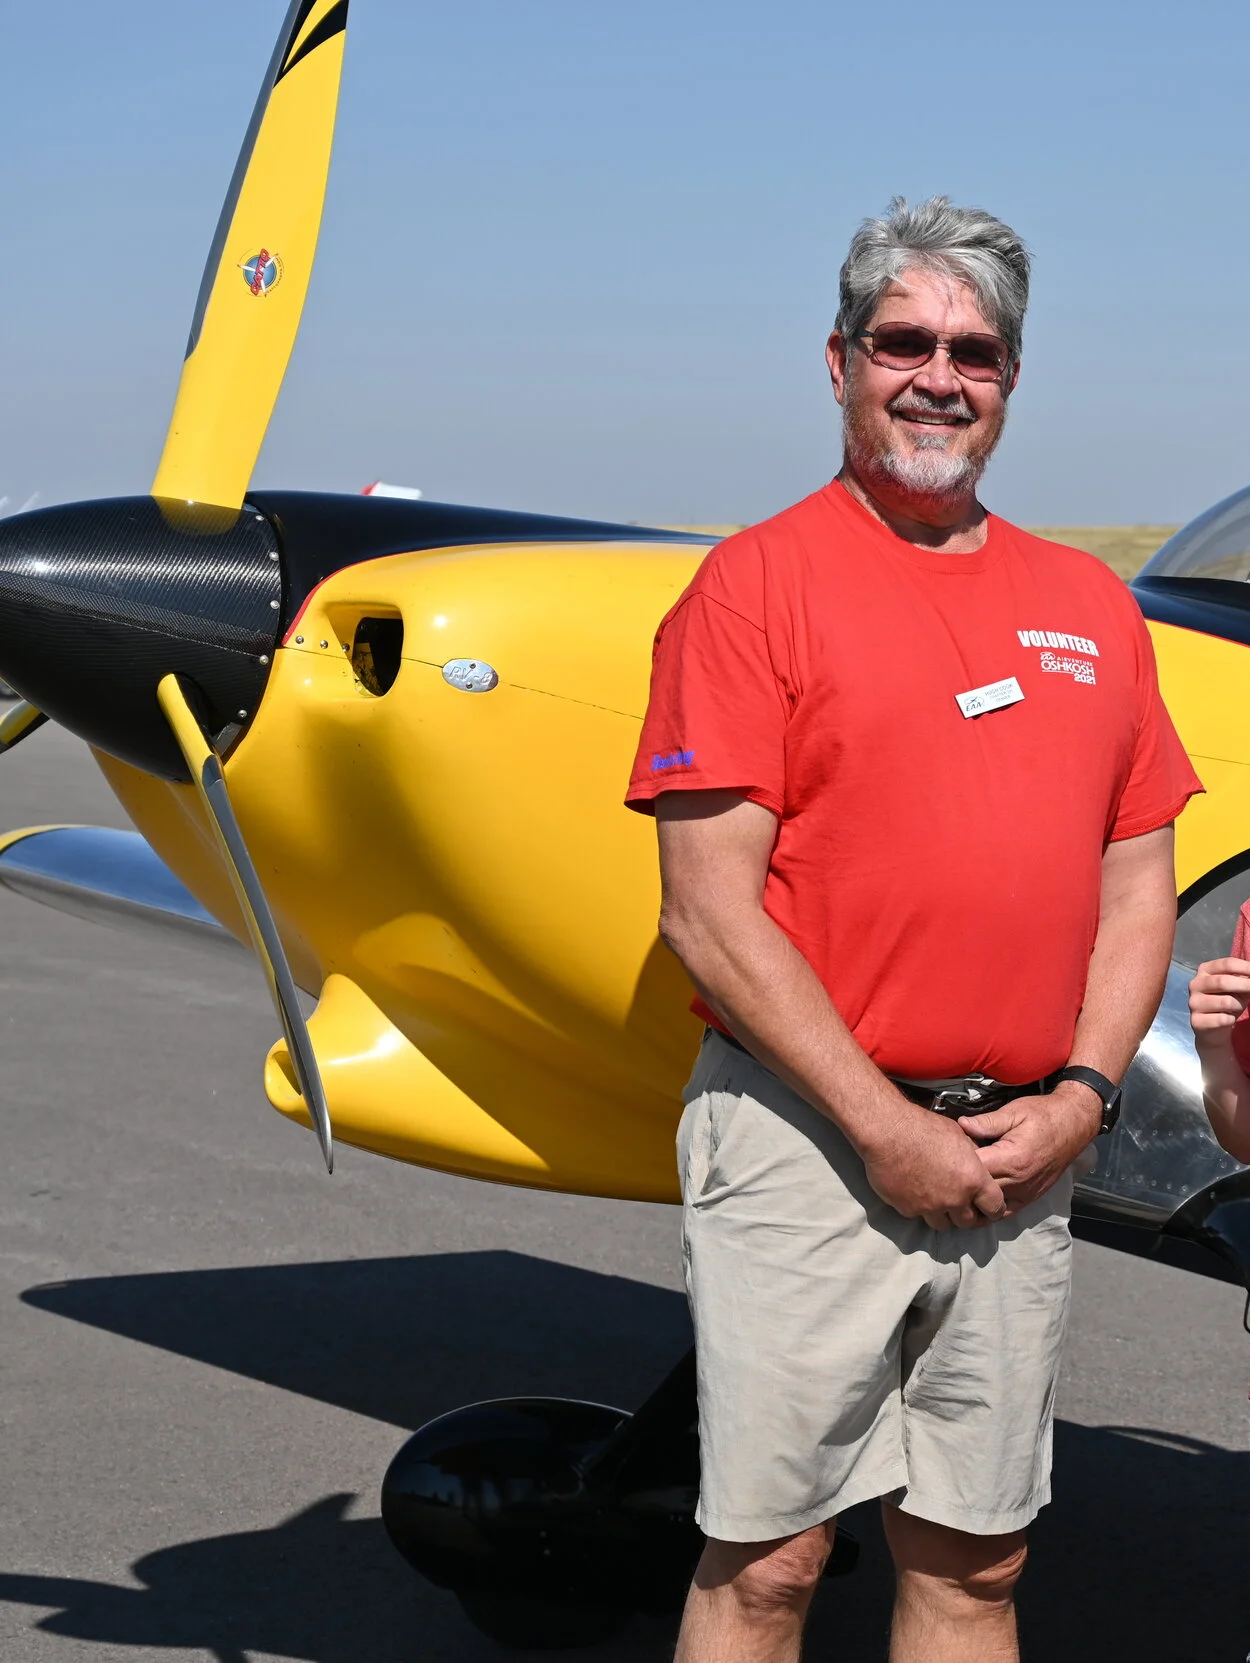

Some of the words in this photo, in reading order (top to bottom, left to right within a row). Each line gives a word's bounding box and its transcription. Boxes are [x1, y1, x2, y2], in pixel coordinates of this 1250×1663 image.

[252, 248, 269, 295] CATTO
[1017, 630, 1100, 657] VOLUNTEER
[1041, 660, 1094, 676] OSHKOSH
[1057, 656, 1093, 667] AIRVENTURE
[1074, 673, 1096, 685] 2021
[966, 701, 982, 712] EAA
